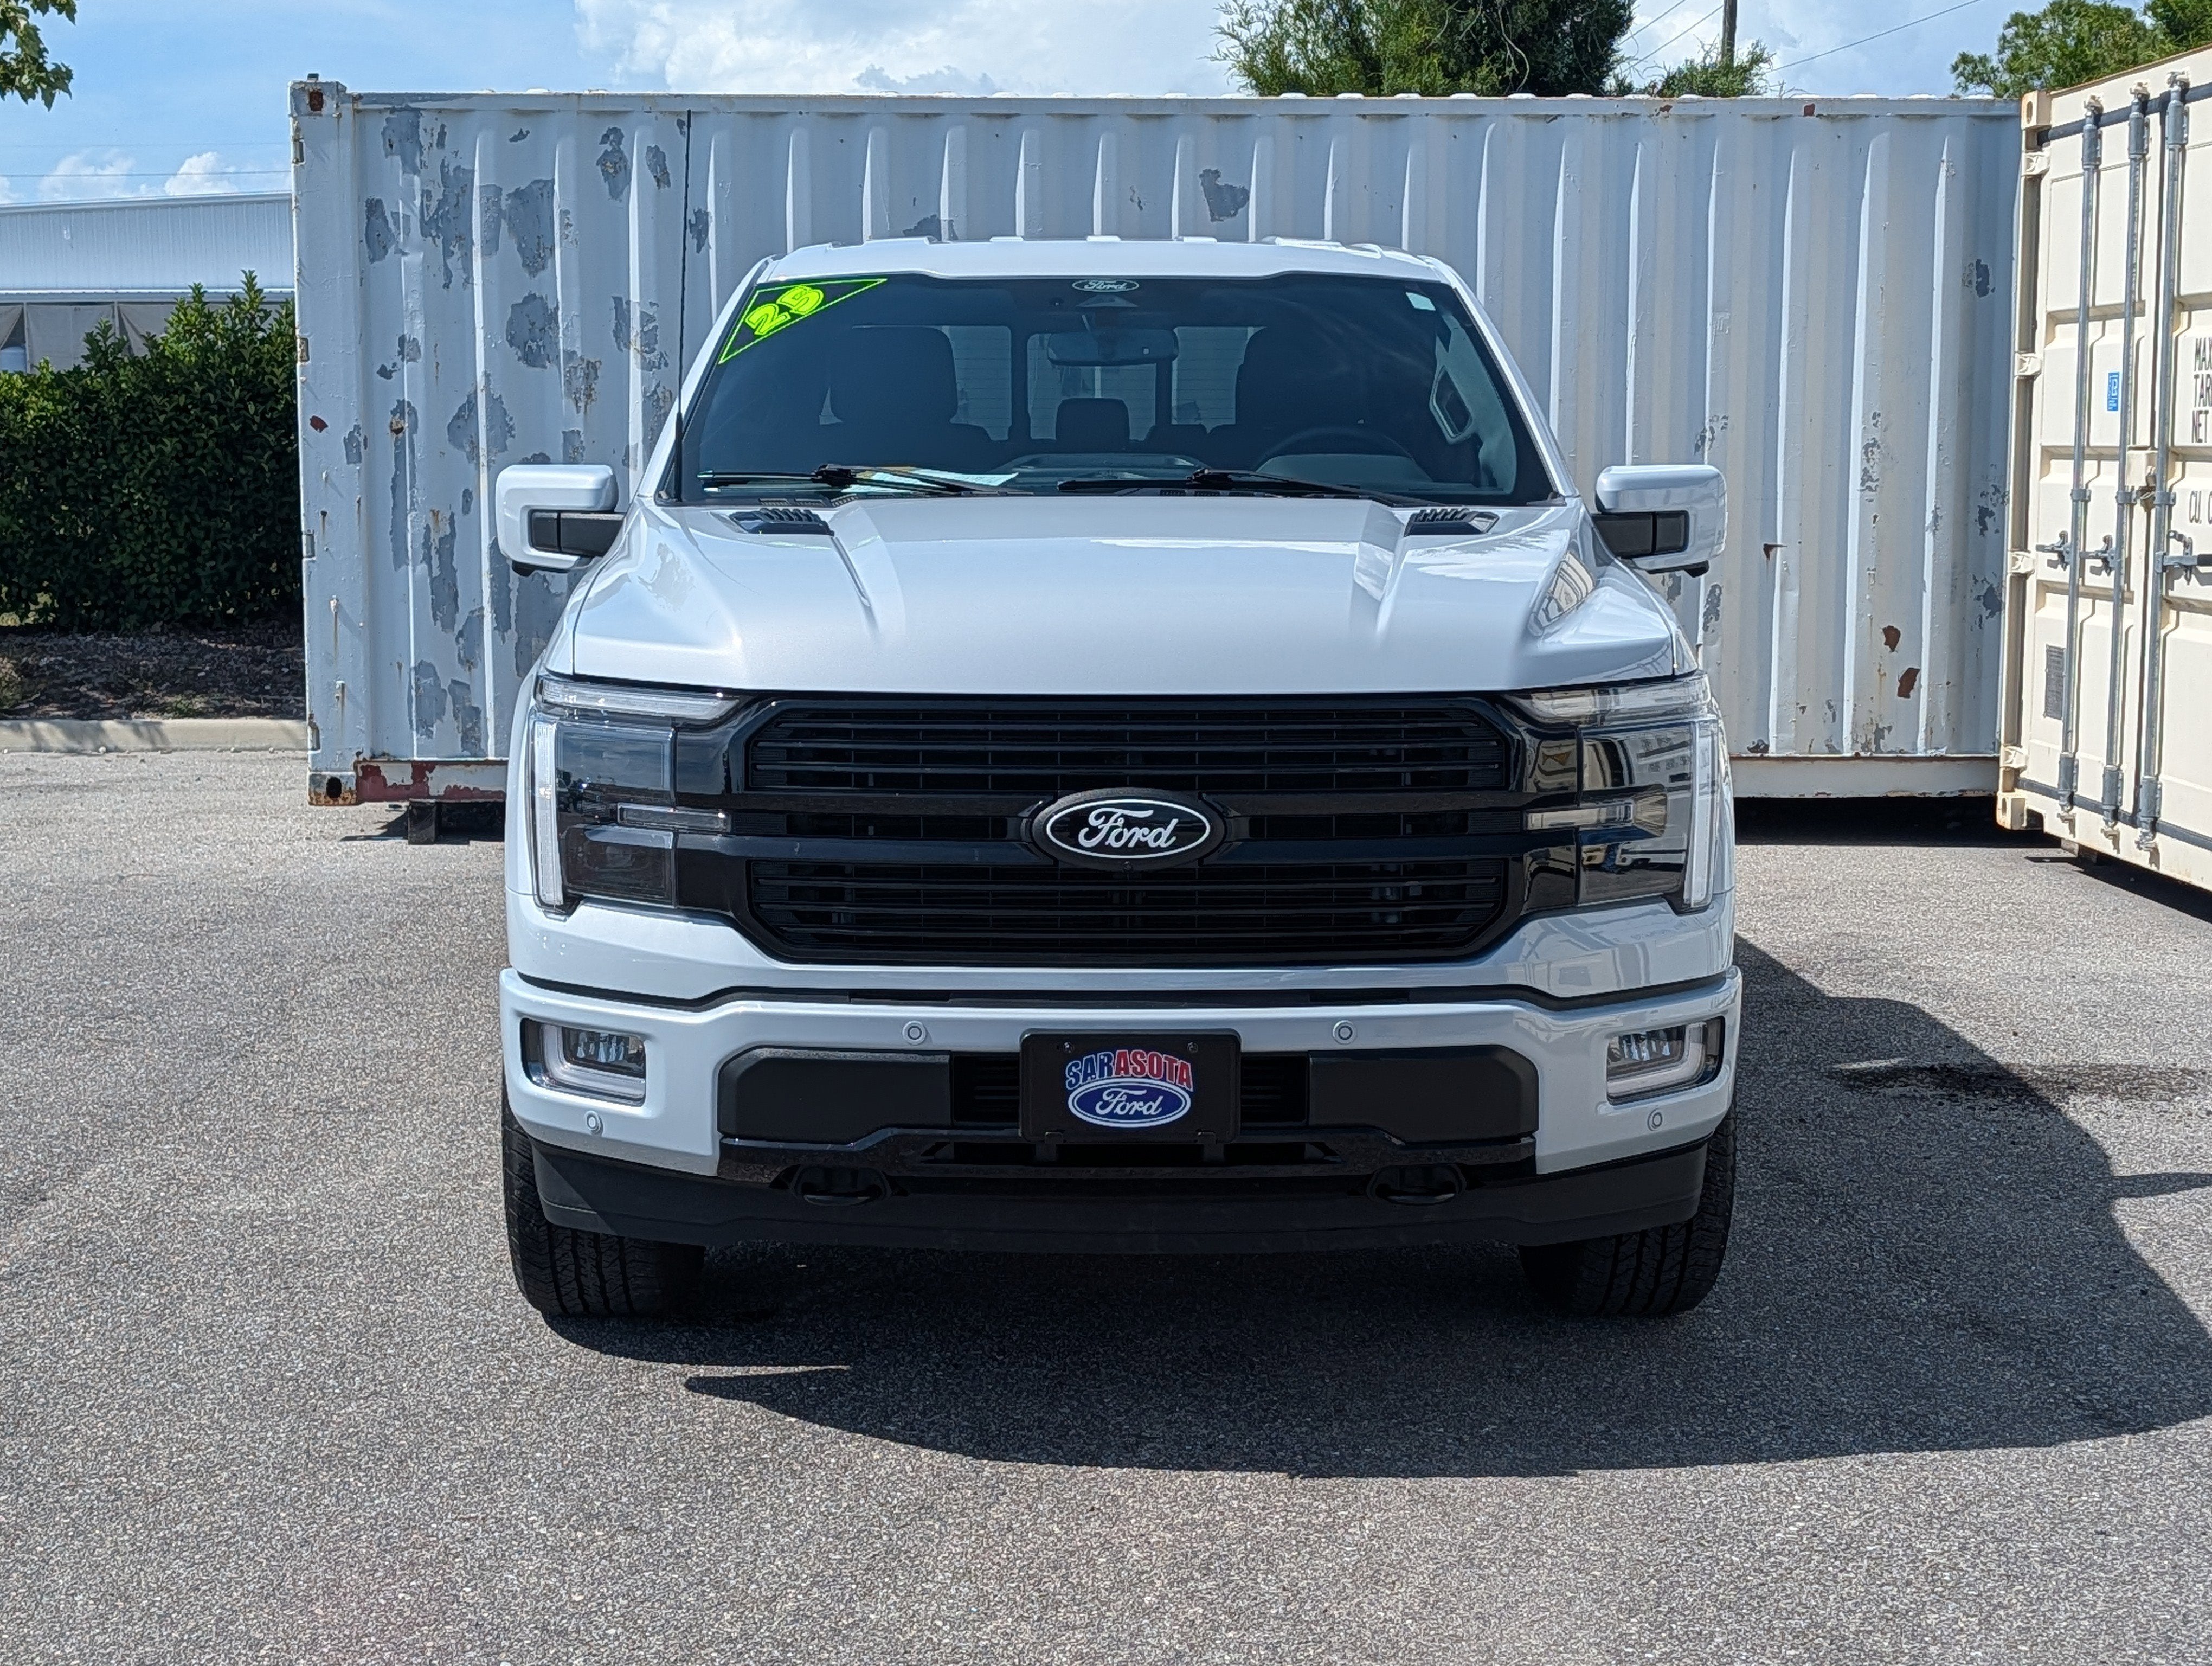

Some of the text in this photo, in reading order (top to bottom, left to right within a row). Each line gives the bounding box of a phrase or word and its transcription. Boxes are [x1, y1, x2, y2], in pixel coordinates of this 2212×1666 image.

[1084, 280, 1127, 290] Ford
[745, 284, 824, 336] 25
[2191, 410, 2209, 443] NET
[1078, 808, 1179, 848] Ford
[1065, 1049, 1194, 1092] SARASOTA
[1095, 1087, 1162, 1116] Ford
